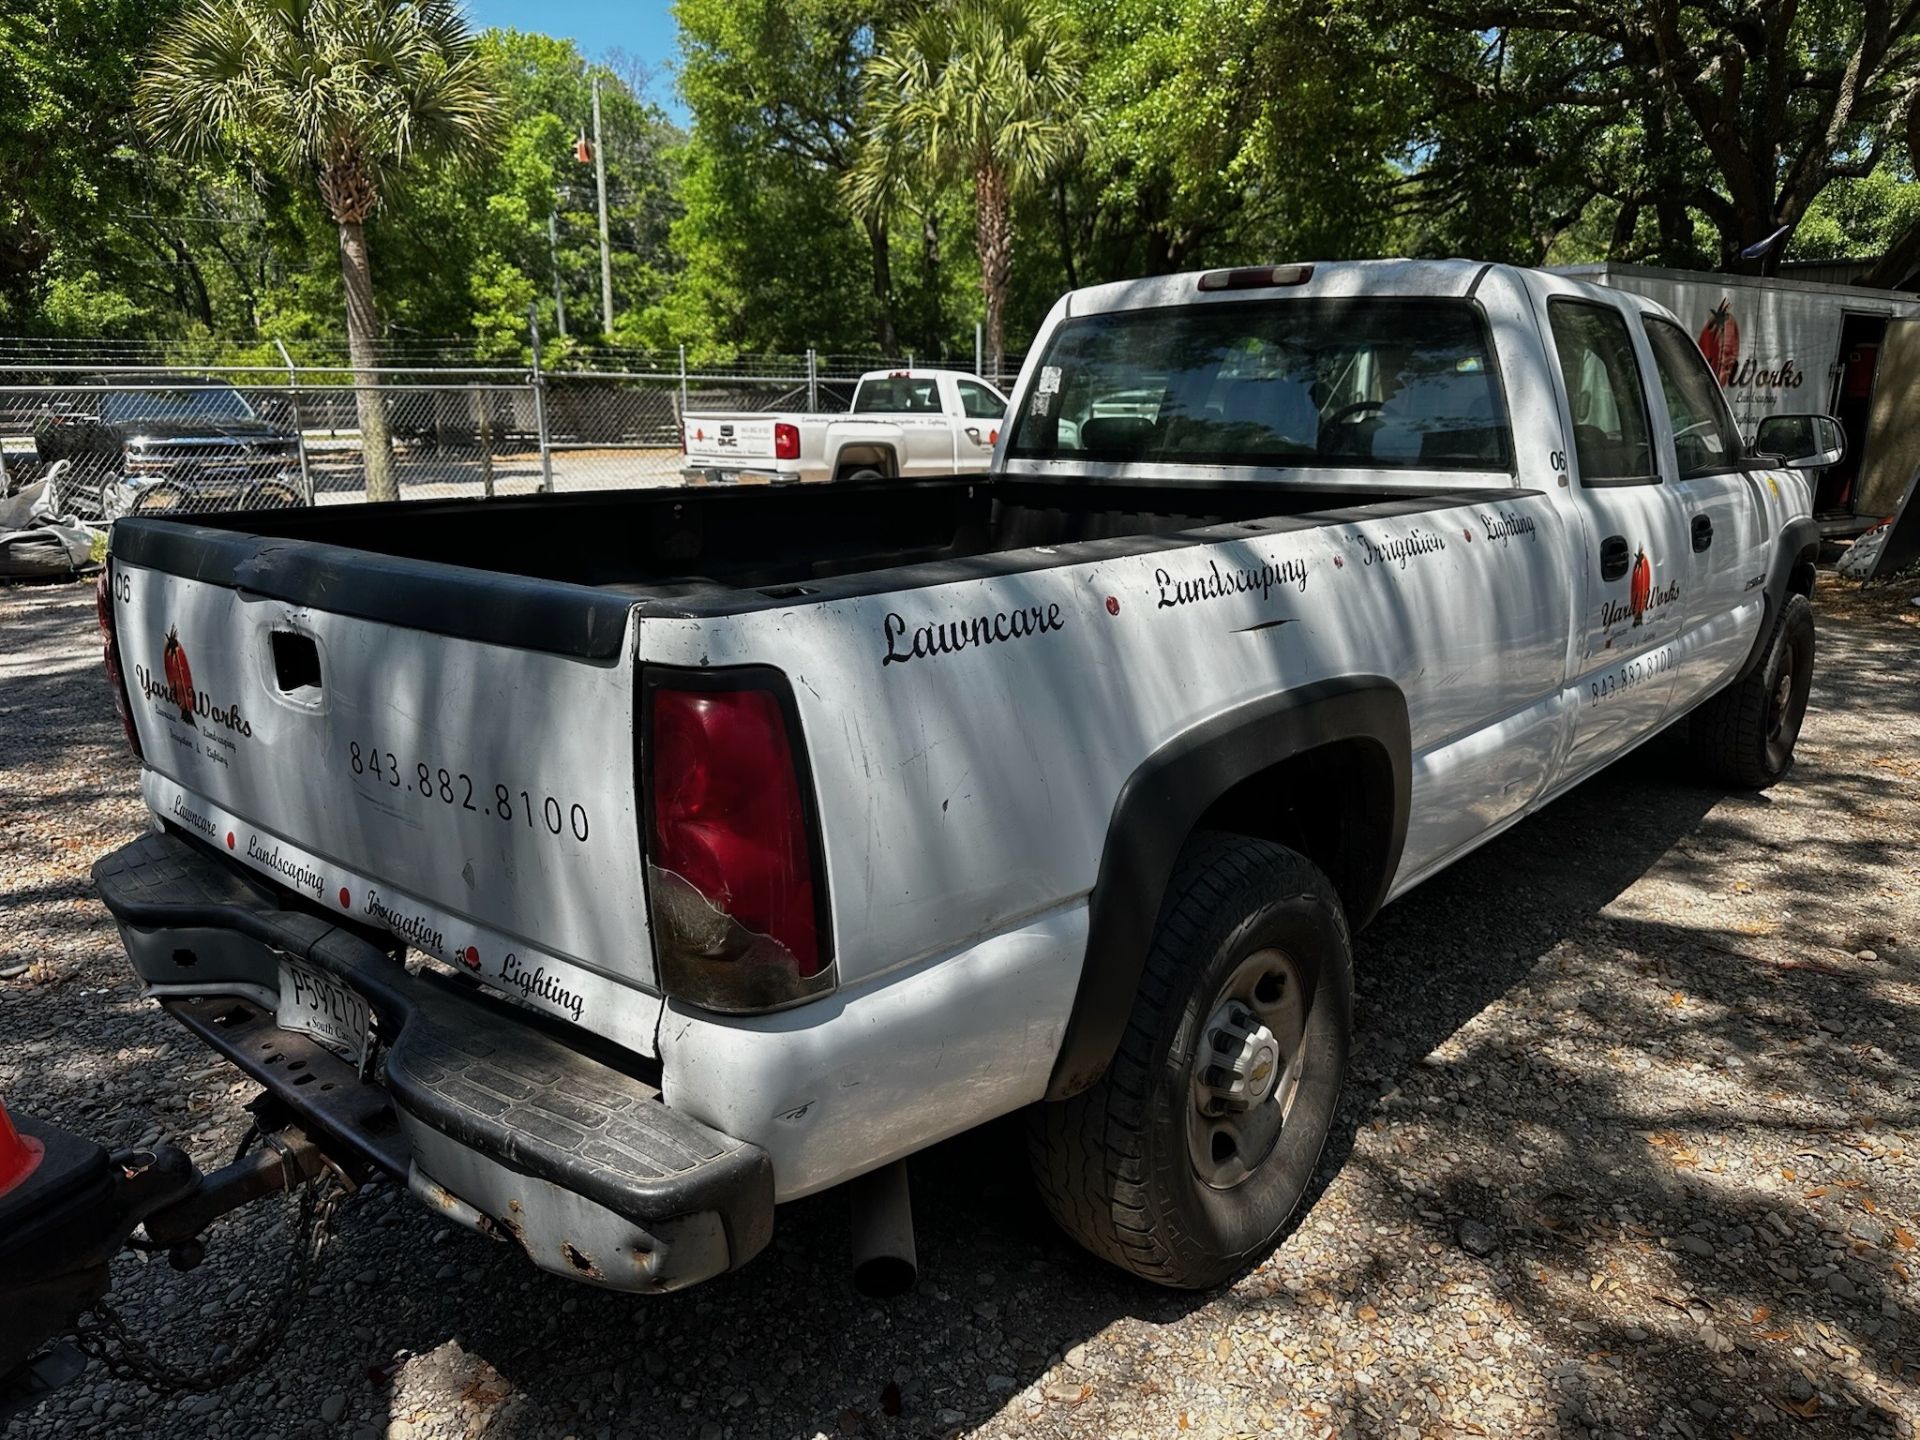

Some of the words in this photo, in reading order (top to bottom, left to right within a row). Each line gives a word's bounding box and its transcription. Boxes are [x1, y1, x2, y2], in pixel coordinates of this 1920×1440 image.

[1728, 359, 1803, 388] Works
[1550, 451, 1566, 471] 06
[115, 575, 131, 603] 06
[882, 602, 1065, 667] Lawncare
[1157, 556, 1309, 610] Landscaping
[1357, 529, 1446, 570] Irrigation
[1481, 512, 1536, 546] Lighting
[1646, 579, 1680, 610] Works
[1592, 647, 1673, 707] 843.882.8100
[135, 663, 181, 707] Yard
[189, 688, 252, 738] Works
[350, 741, 589, 843] 843.882.8100
[174, 795, 217, 837] Lawncare
[247, 834, 325, 898] Landscaping
[364, 889, 443, 952] Irrigation
[500, 953, 585, 1021] Lighting
[311, 1015, 333, 1036] South
